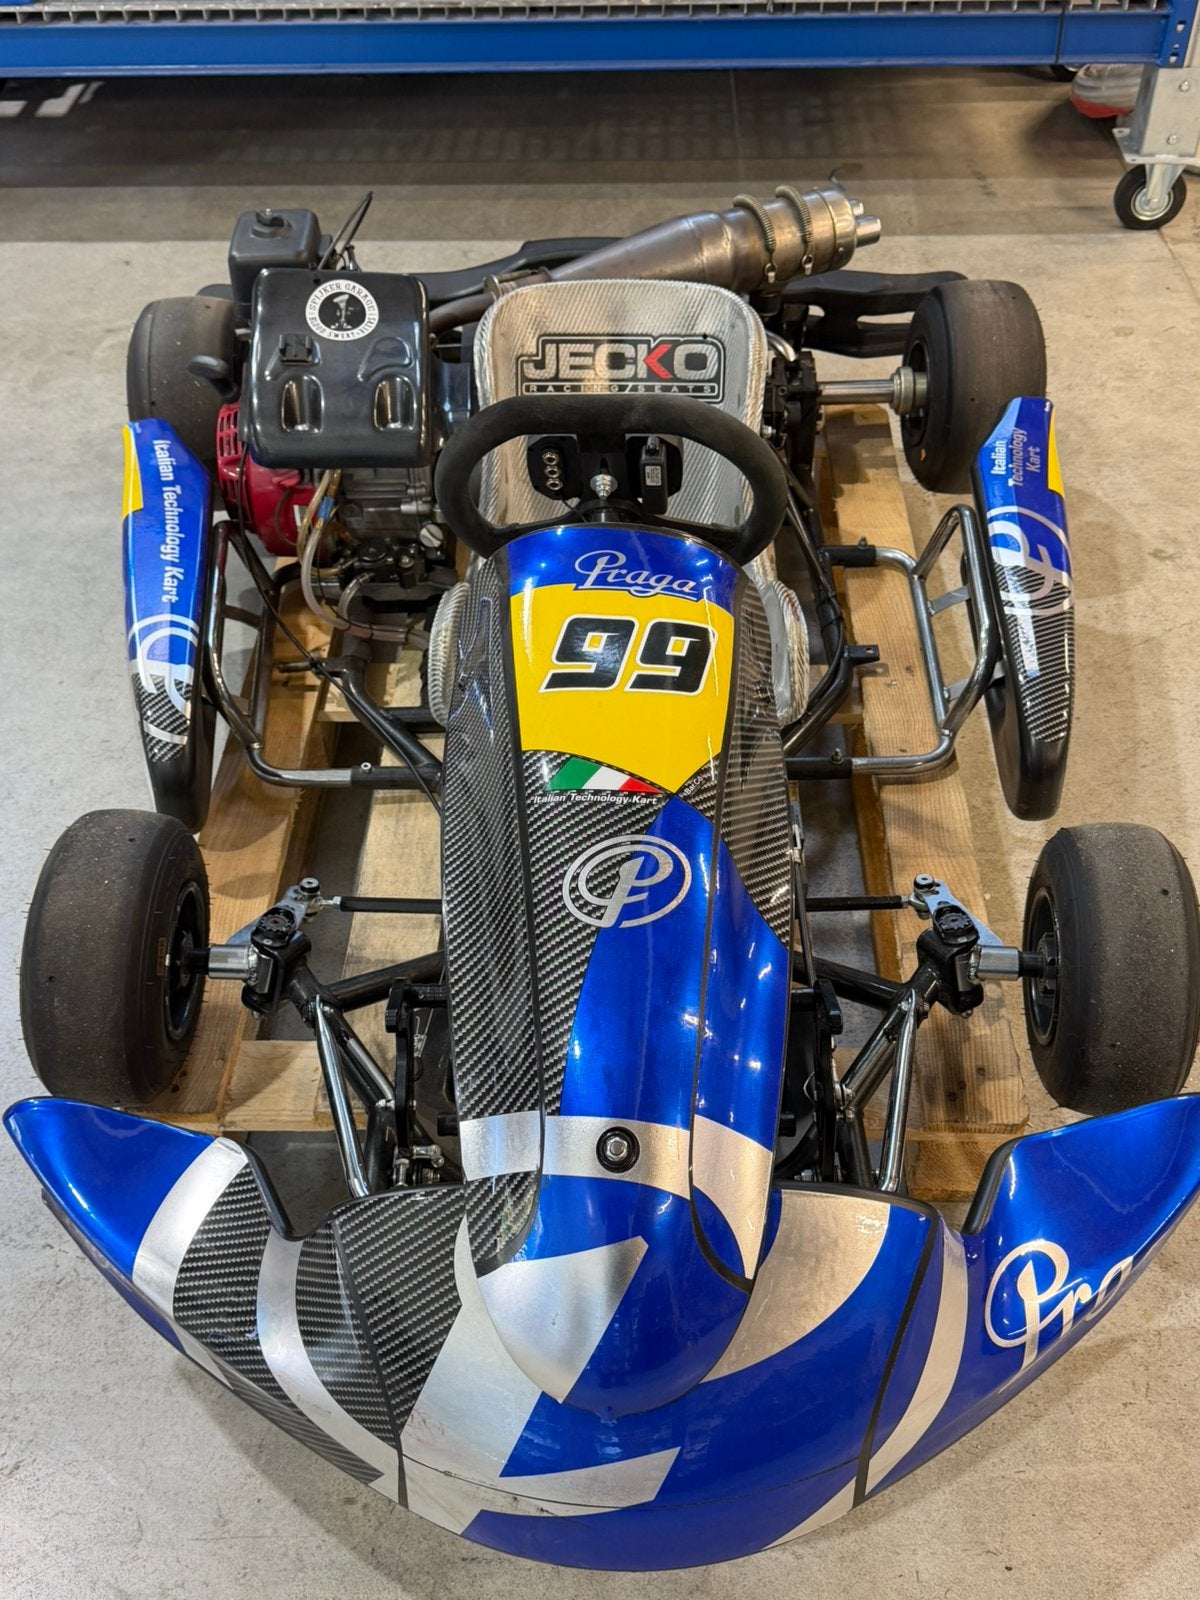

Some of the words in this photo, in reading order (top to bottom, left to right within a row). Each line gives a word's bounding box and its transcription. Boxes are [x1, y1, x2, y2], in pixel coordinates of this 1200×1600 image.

[345, 283, 376, 312] GARAGE
[523, 343, 719, 380] JECKO
[152, 439, 177, 482] Italian
[990, 439, 1007, 475] Italian
[1008, 427, 1027, 487] Technology
[1025, 446, 1041, 472] Kart
[160, 484, 185, 563] Technology
[161, 565, 185, 603] Kart
[574, 550, 699, 600] Praga
[539, 615, 718, 696] 99
[533, 794, 566, 804] Italian
[570, 793, 629, 805] Technology
[632, 794, 659, 805] Kart
